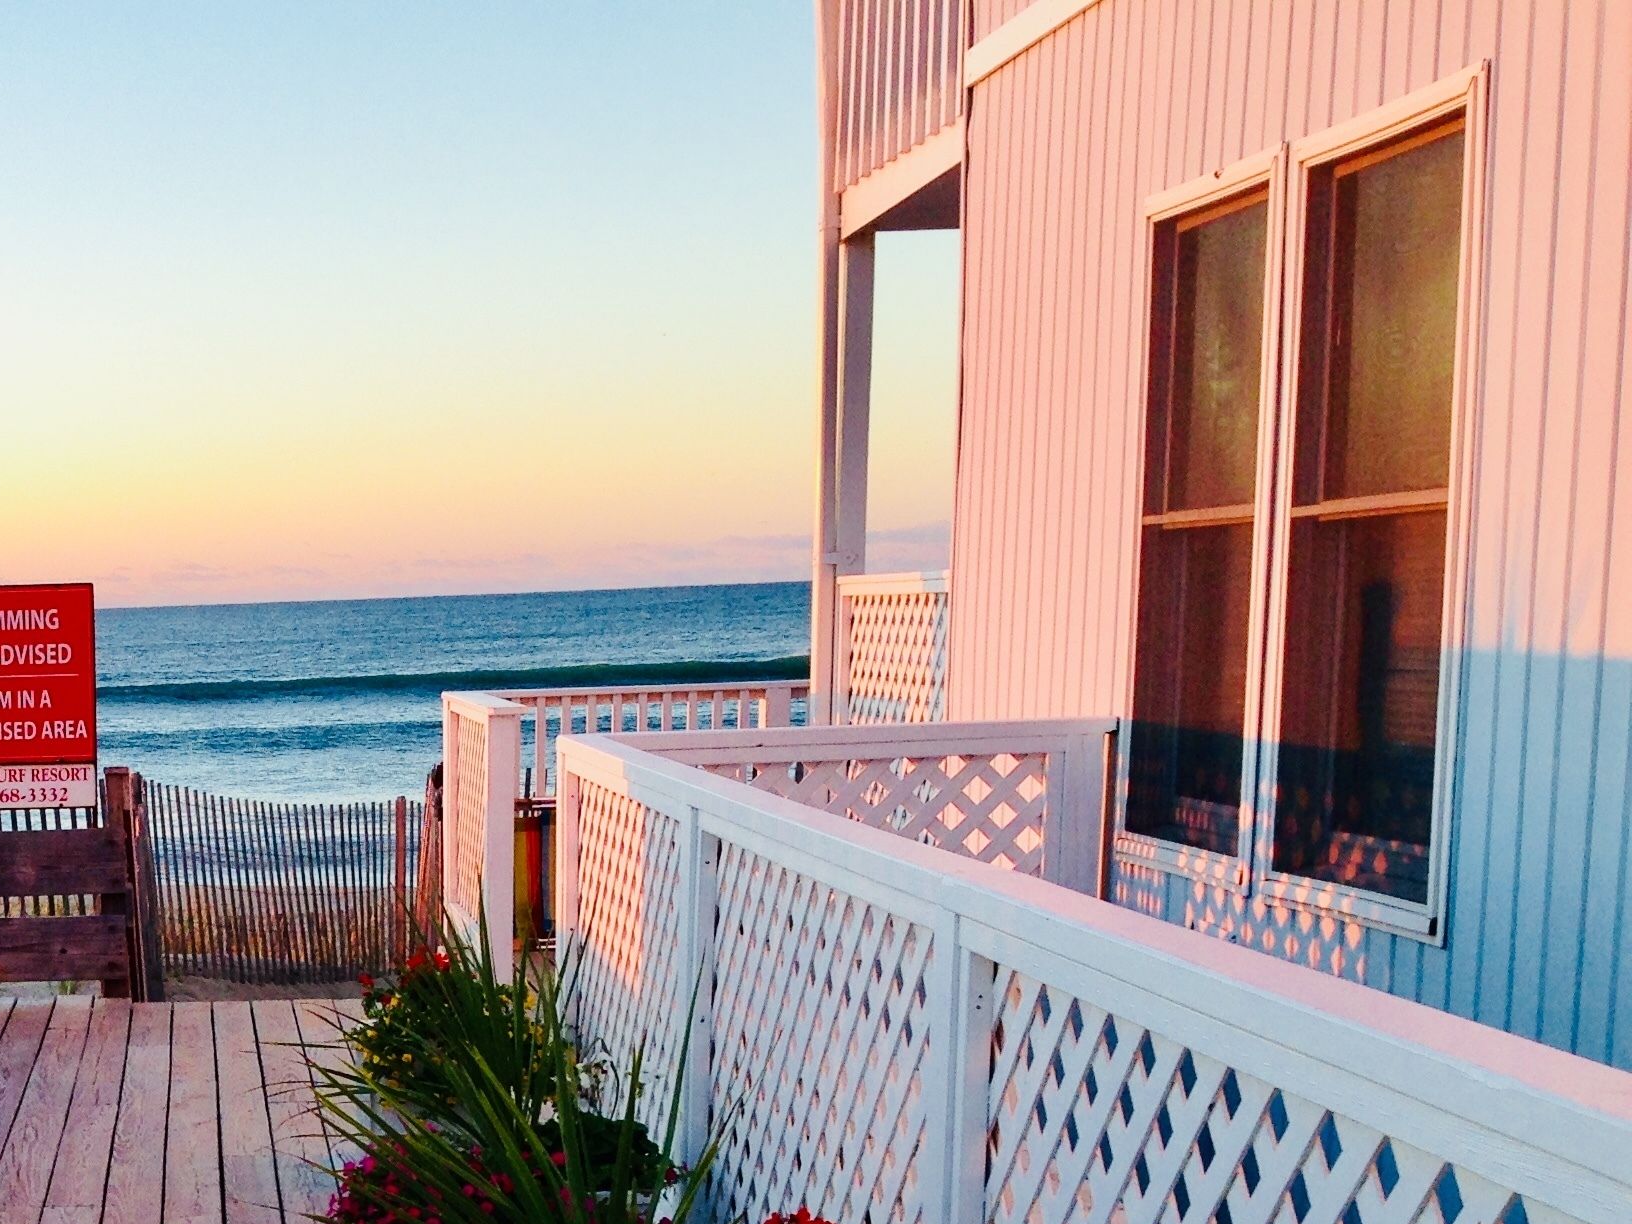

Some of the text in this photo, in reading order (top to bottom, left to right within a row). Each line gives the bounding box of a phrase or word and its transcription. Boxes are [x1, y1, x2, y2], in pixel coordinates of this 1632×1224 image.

[17, 690, 35, 709] IN
[39, 689, 52, 708] A
[41, 720, 88, 740] AREA
[31, 767, 90, 782] RESORT
